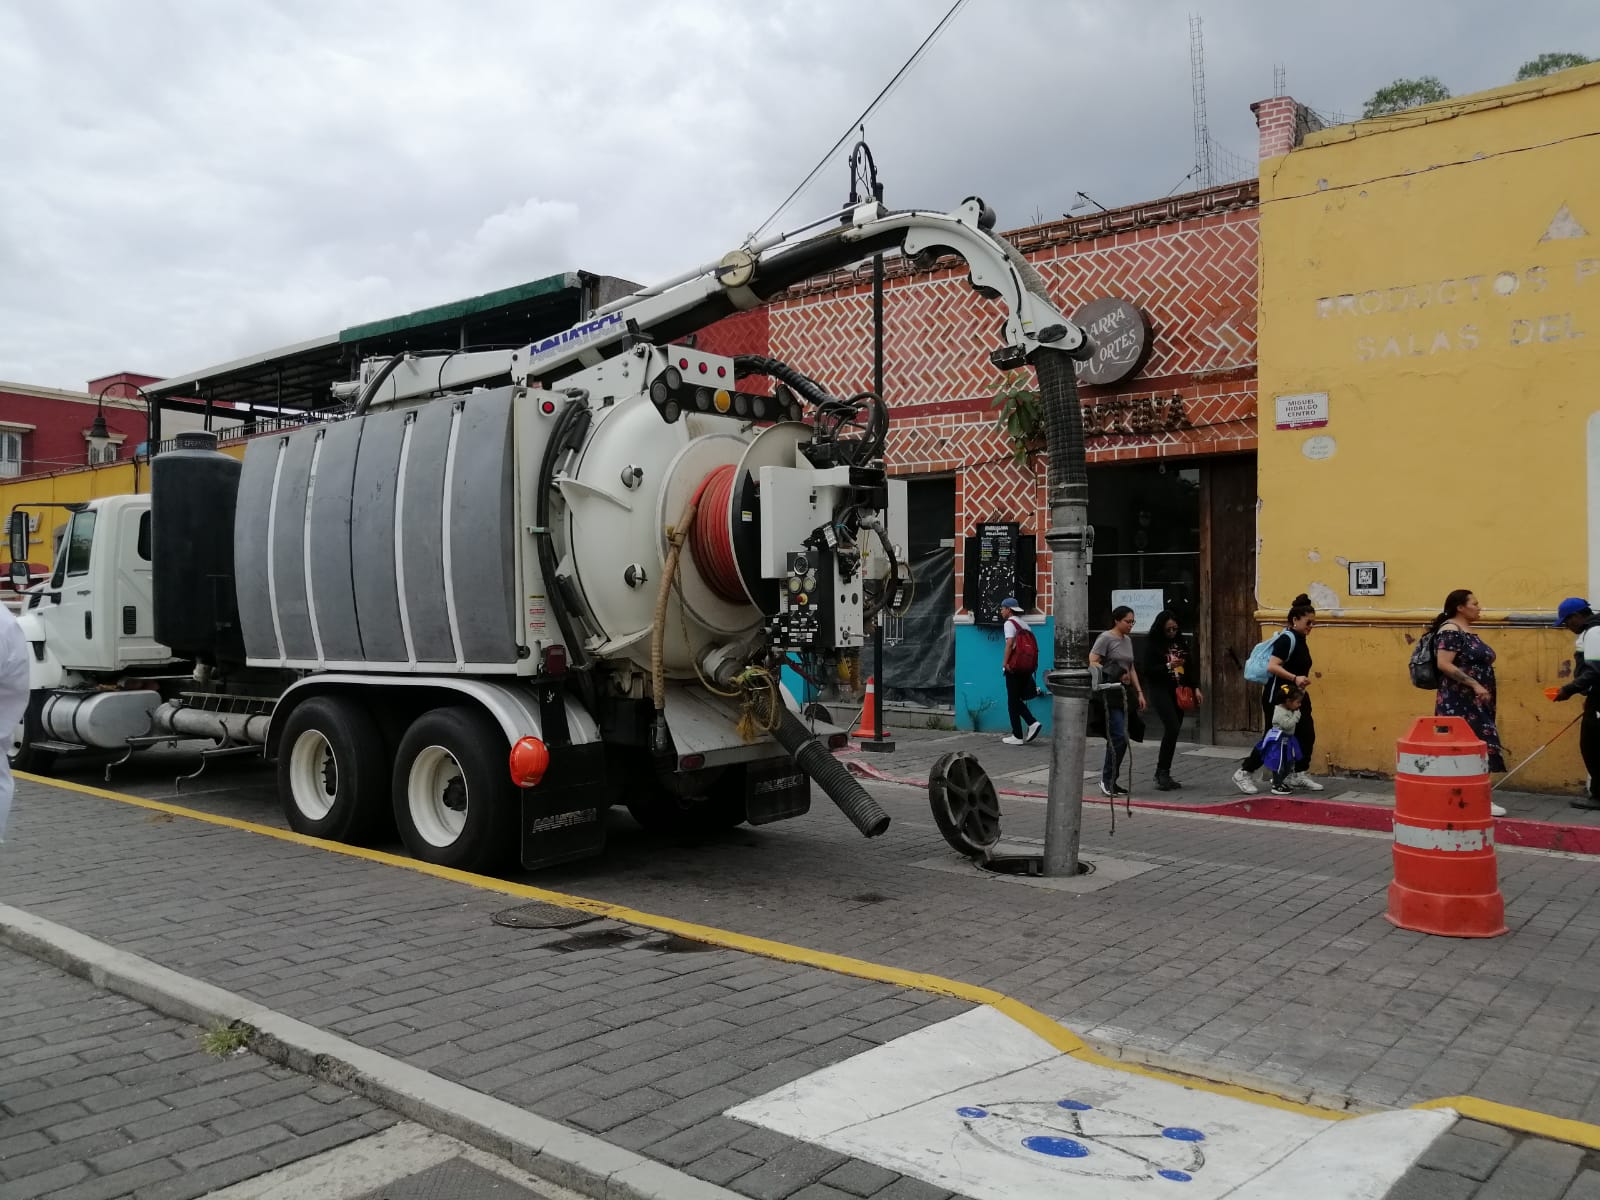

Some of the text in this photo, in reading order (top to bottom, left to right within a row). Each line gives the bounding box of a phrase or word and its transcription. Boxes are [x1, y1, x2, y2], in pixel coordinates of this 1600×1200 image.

[1315, 265, 1549, 320] PRODUCTOS
[1081, 307, 1126, 338] ARRA
[1356, 312, 1585, 361] SALAS DEL
[1285, 404, 1318, 412] HIDALGO
[1287, 399, 1315, 407] MIGUEL
